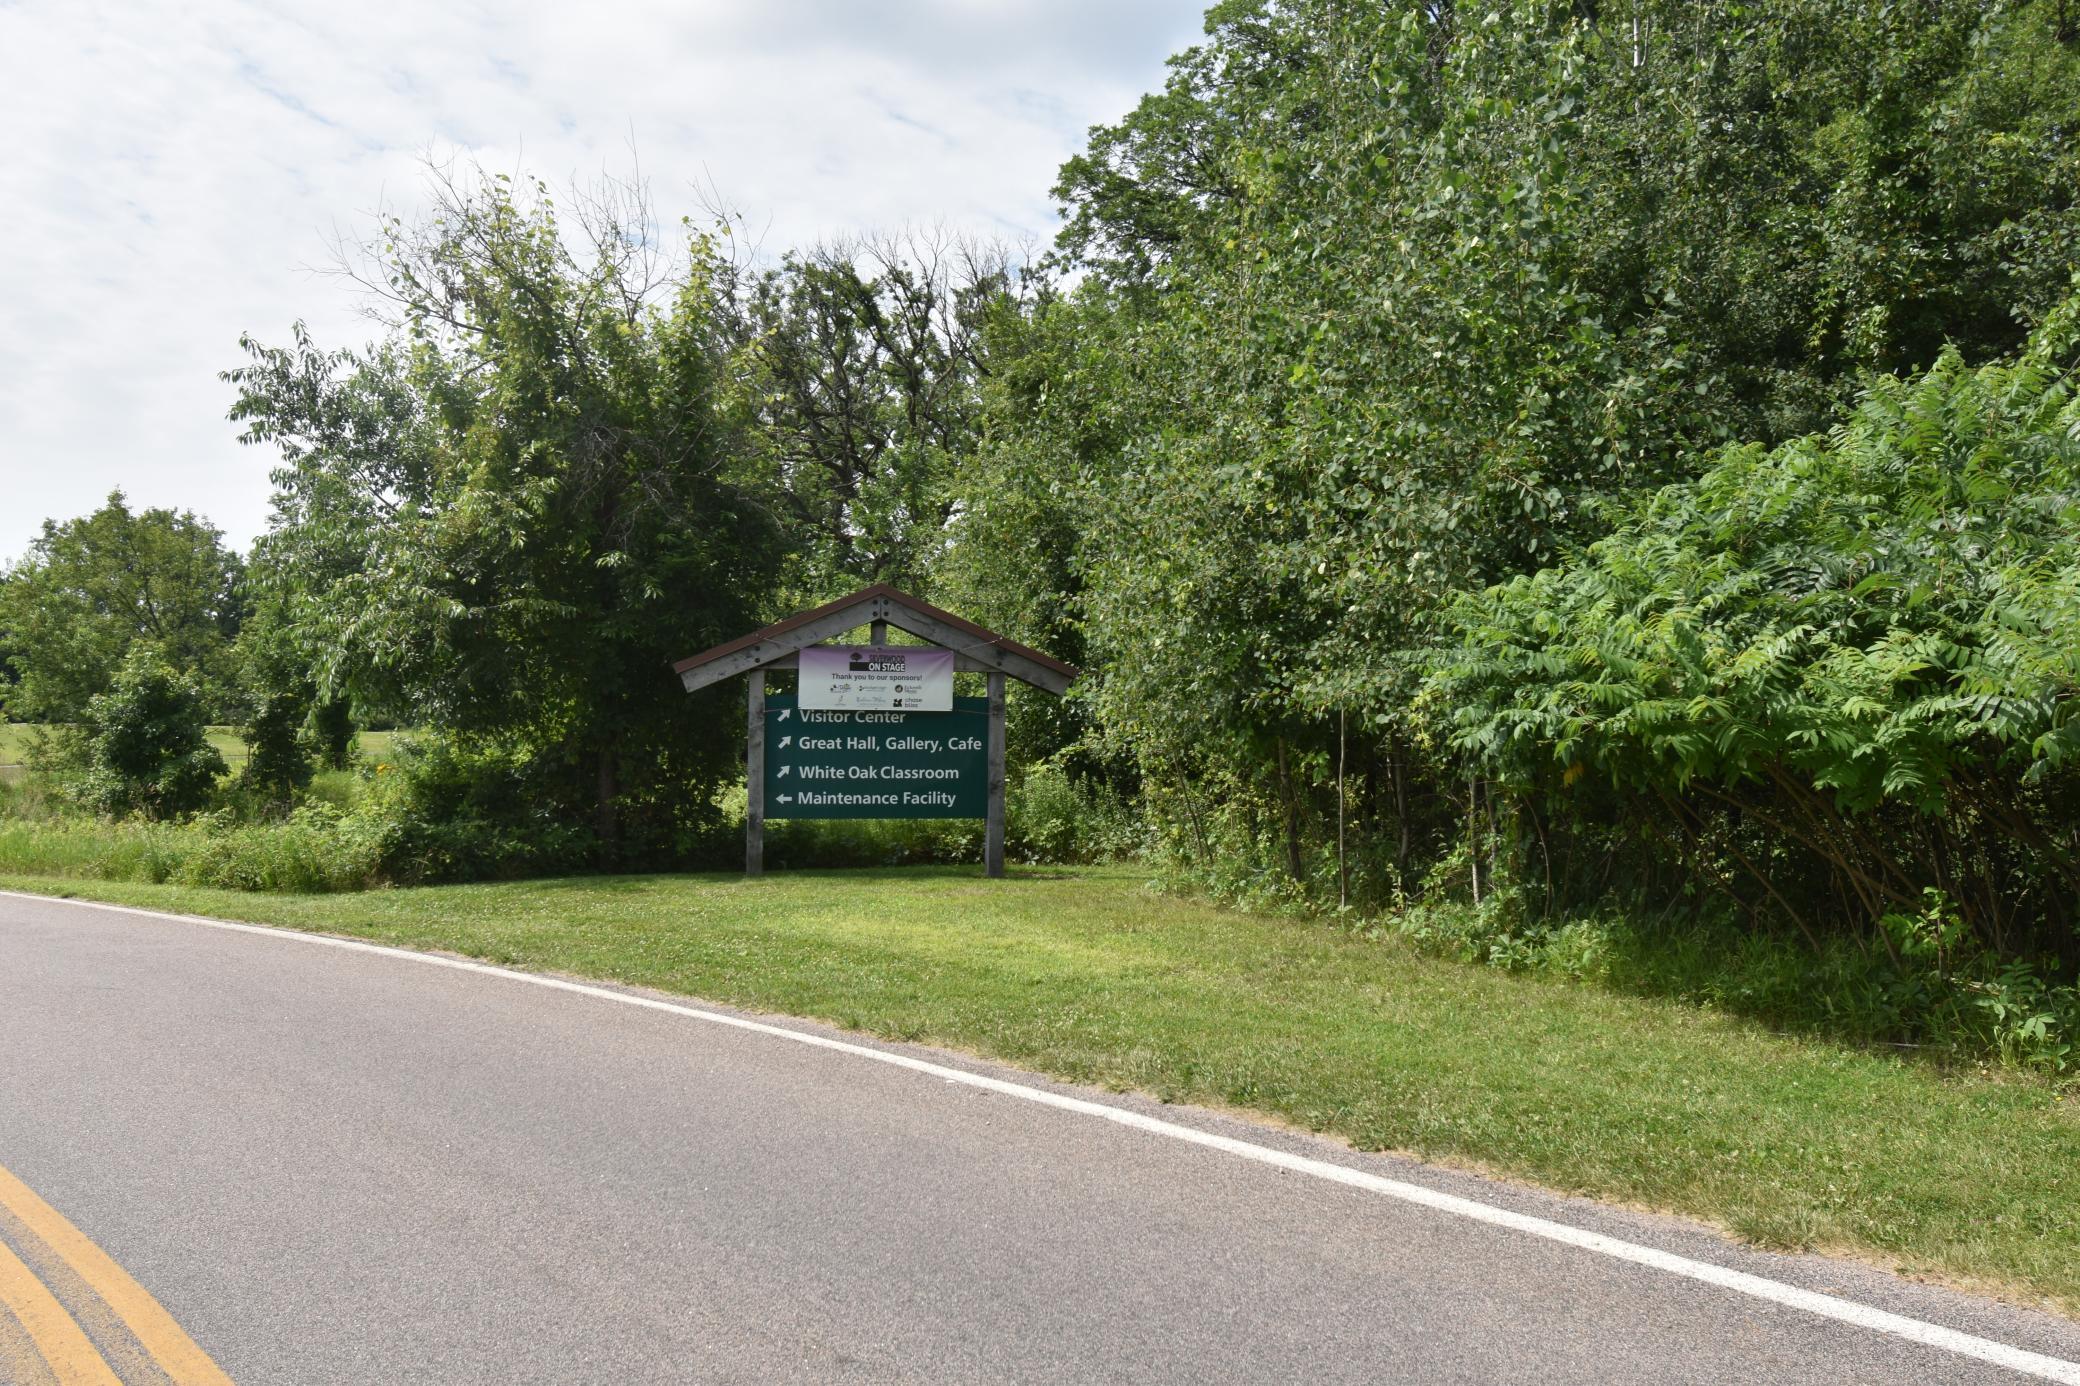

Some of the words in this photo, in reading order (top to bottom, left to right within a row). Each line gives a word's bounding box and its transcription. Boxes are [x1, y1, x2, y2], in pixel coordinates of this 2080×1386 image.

[868, 663, 881, 671] ON
[882, 663, 905, 672] STAGE
[832, 673, 852, 681] Thank
[889, 674, 923, 682] sponsors!
[800, 710, 850, 723] Visitor
[855, 711, 906, 724] Center
[799, 737, 842, 750] Great
[847, 737, 880, 751] Hall,
[886, 737, 943, 753] Gallery,
[948, 737, 982, 751] Cafe
[799, 766, 845, 779] White
[848, 766, 878, 779] Oak
[880, 766, 959, 779] Classroom
[798, 792, 898, 805] Maintenance
[903, 791, 956, 807] Facility
